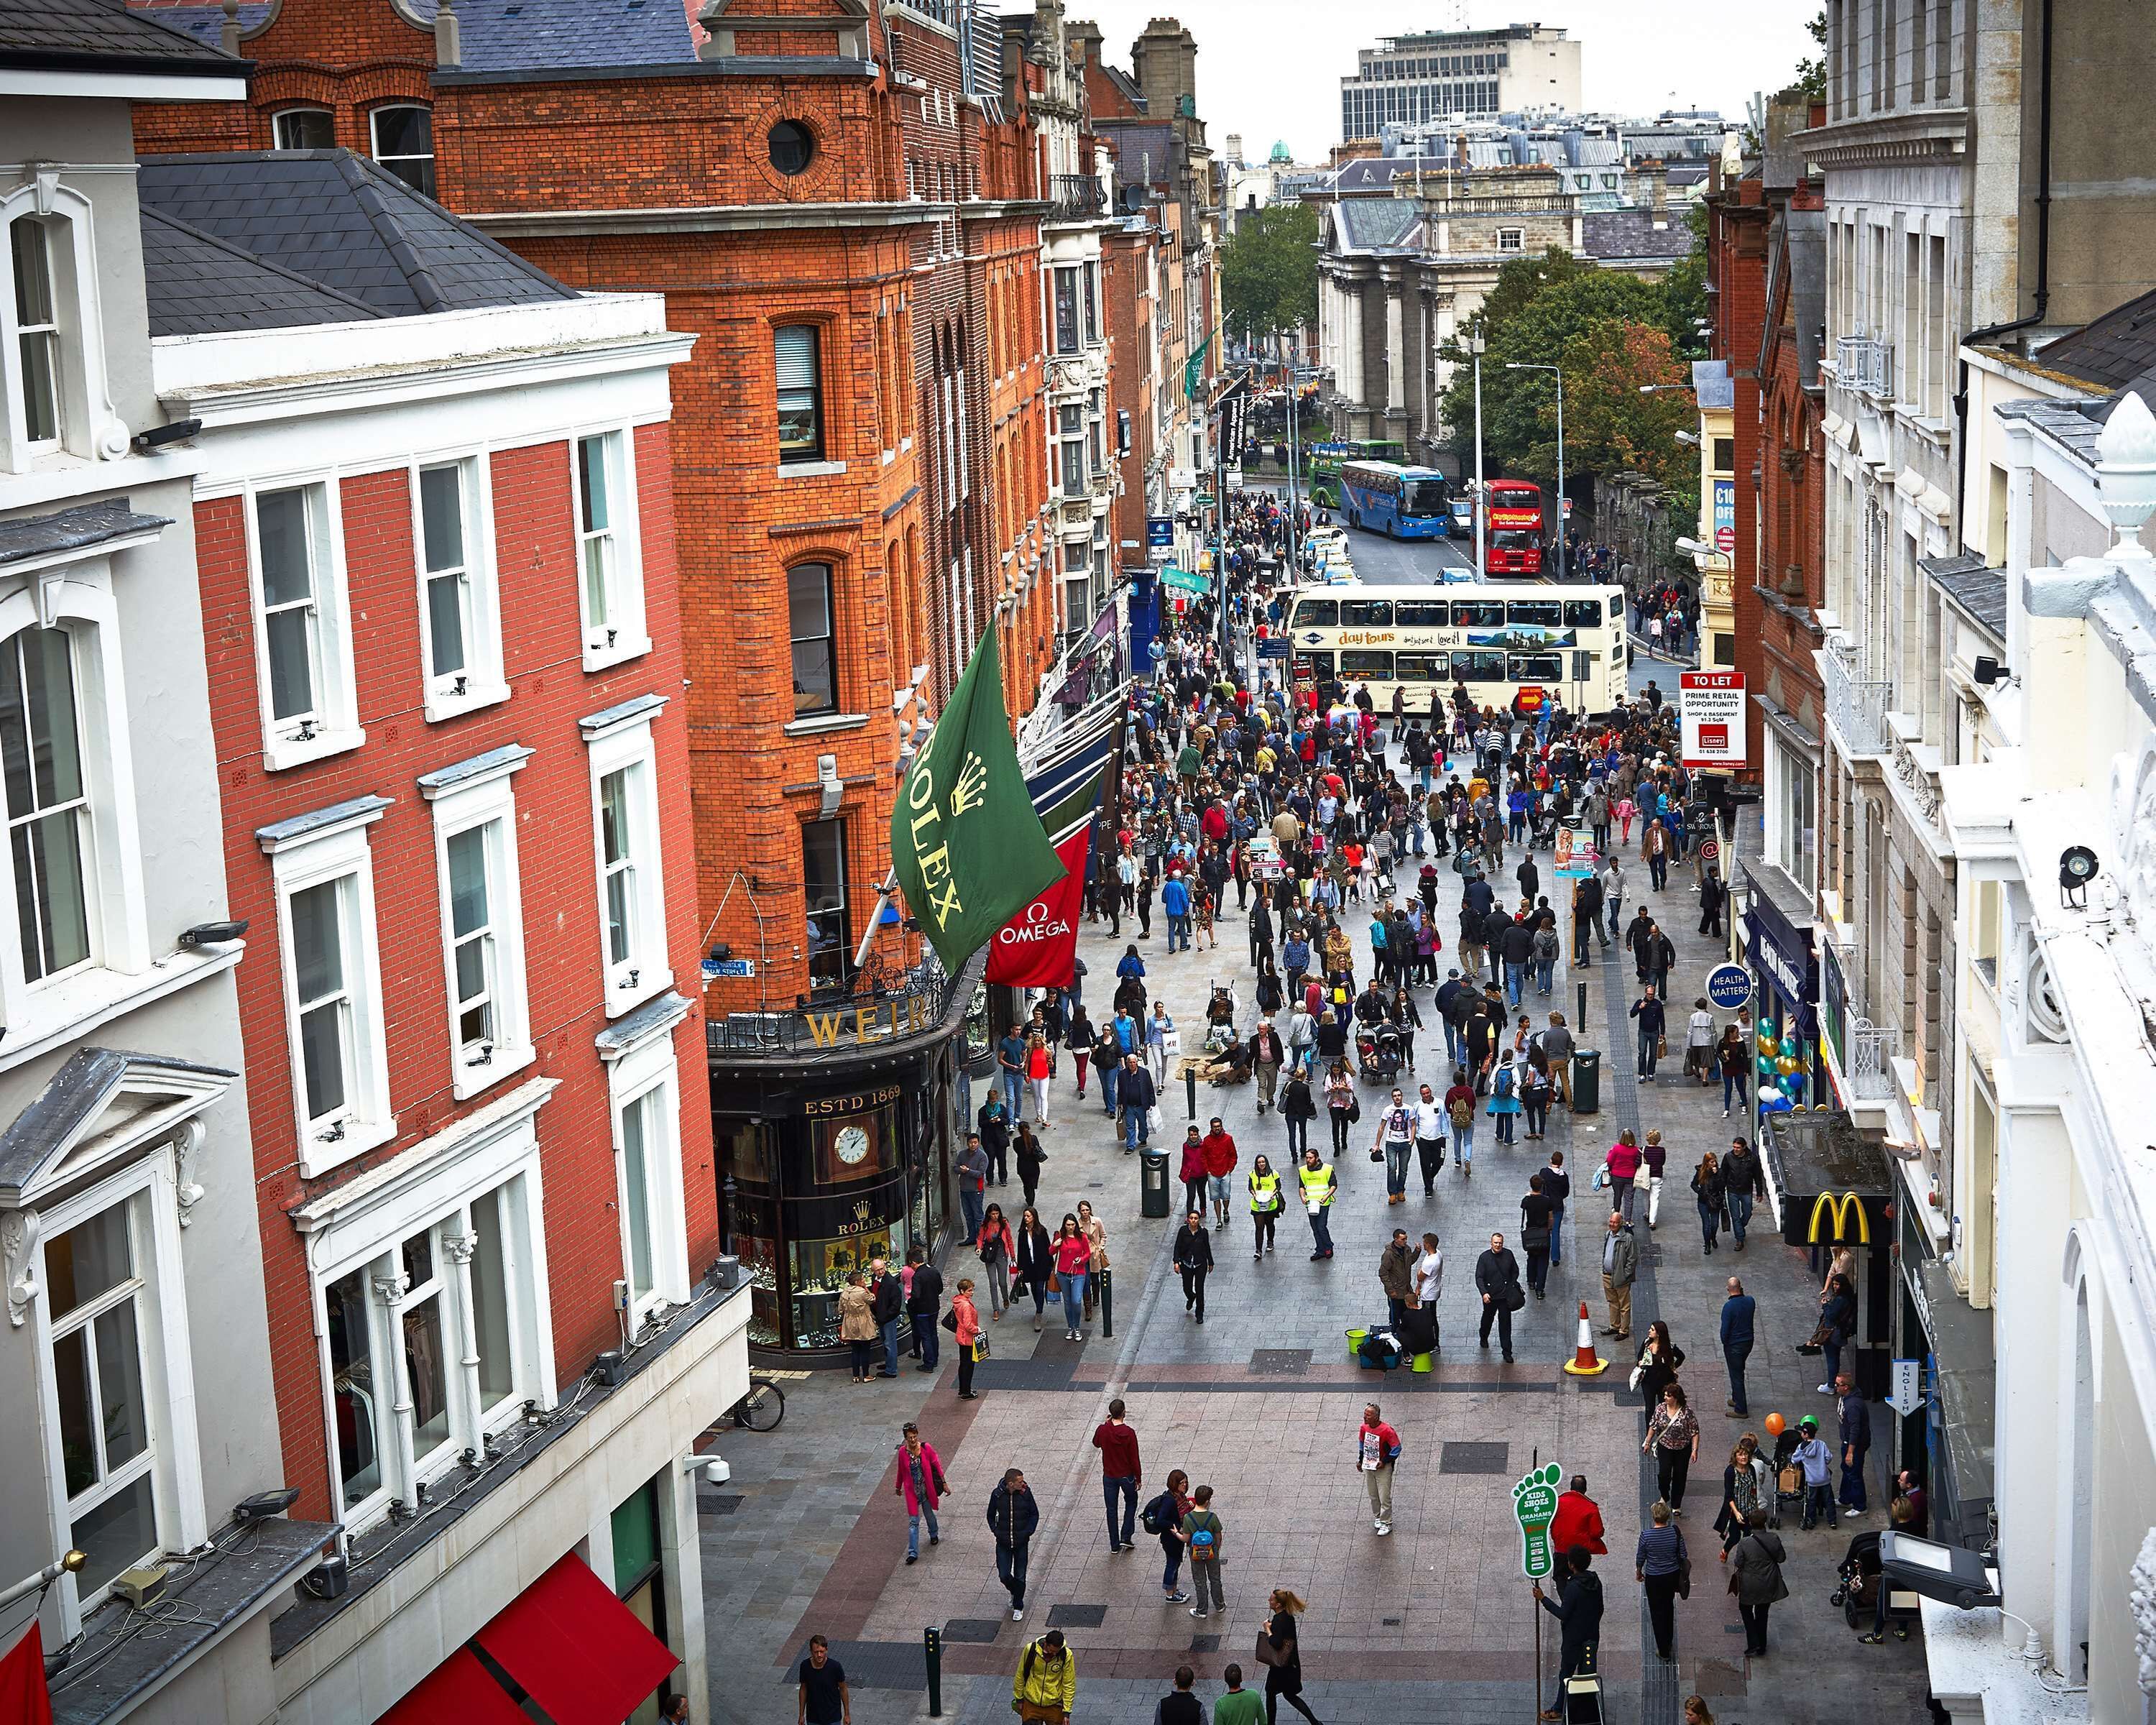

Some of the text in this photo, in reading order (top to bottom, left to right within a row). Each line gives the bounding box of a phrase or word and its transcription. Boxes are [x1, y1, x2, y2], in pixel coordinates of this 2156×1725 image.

[1227, 428, 1236, 461] American
[1339, 632, 1363, 645] day
[1365, 632, 1395, 645] tours
[1692, 676, 1731, 686] TO LET
[909, 723, 963, 934] ROLEX
[1000, 918, 1070, 944] OMEGA
[1714, 975, 1744, 985] HEALTH
[1712, 985, 1749, 997] MATTERS
[805, 995, 927, 1049] WEIR
[805, 1085, 900, 1114] ESTD 1869
[838, 1215, 886, 1236] ROLEX
[1902, 1364, 1911, 1412] ENGLISH
[1524, 1498, 1549, 1508] SHOES
[1526, 1491, 1546, 1500] KIDS
[1520, 1511, 1552, 1520] GRAHAMS
